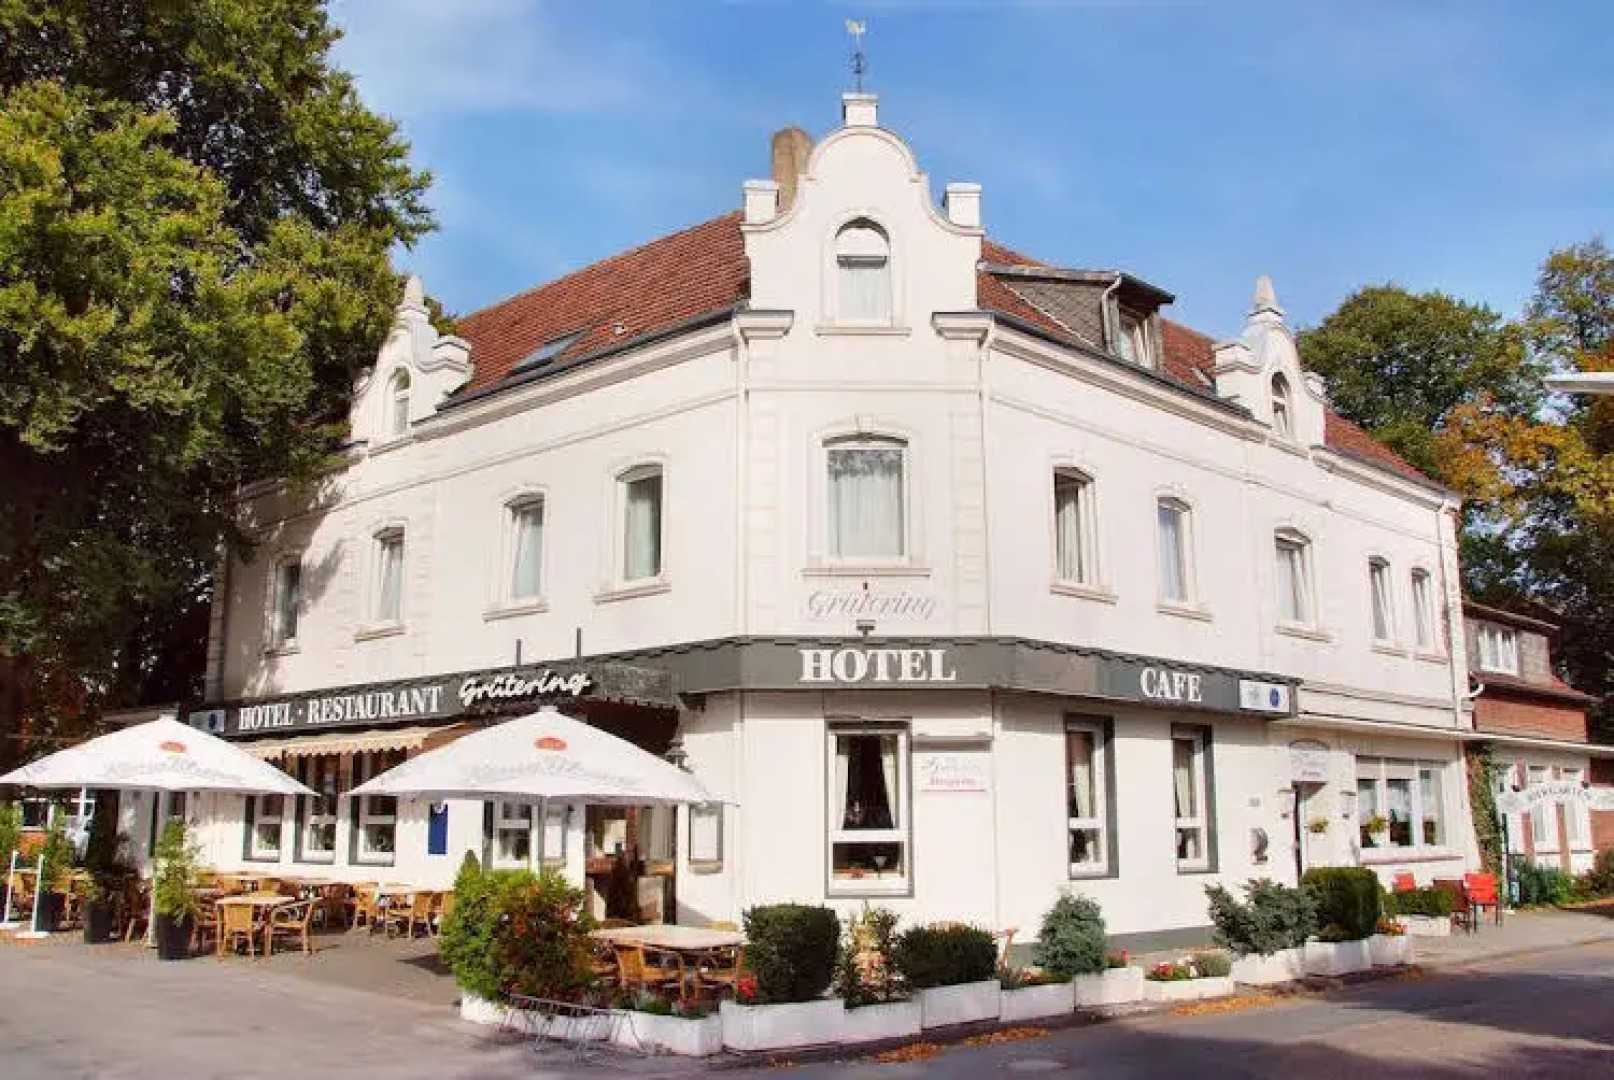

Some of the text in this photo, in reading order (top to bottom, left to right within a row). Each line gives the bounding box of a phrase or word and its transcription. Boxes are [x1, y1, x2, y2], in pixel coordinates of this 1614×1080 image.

[800, 649, 957, 682] HOTEL
[1140, 667, 1202, 702] CAFE
[238, 686, 442, 730] HOTEL RESTAURANT
